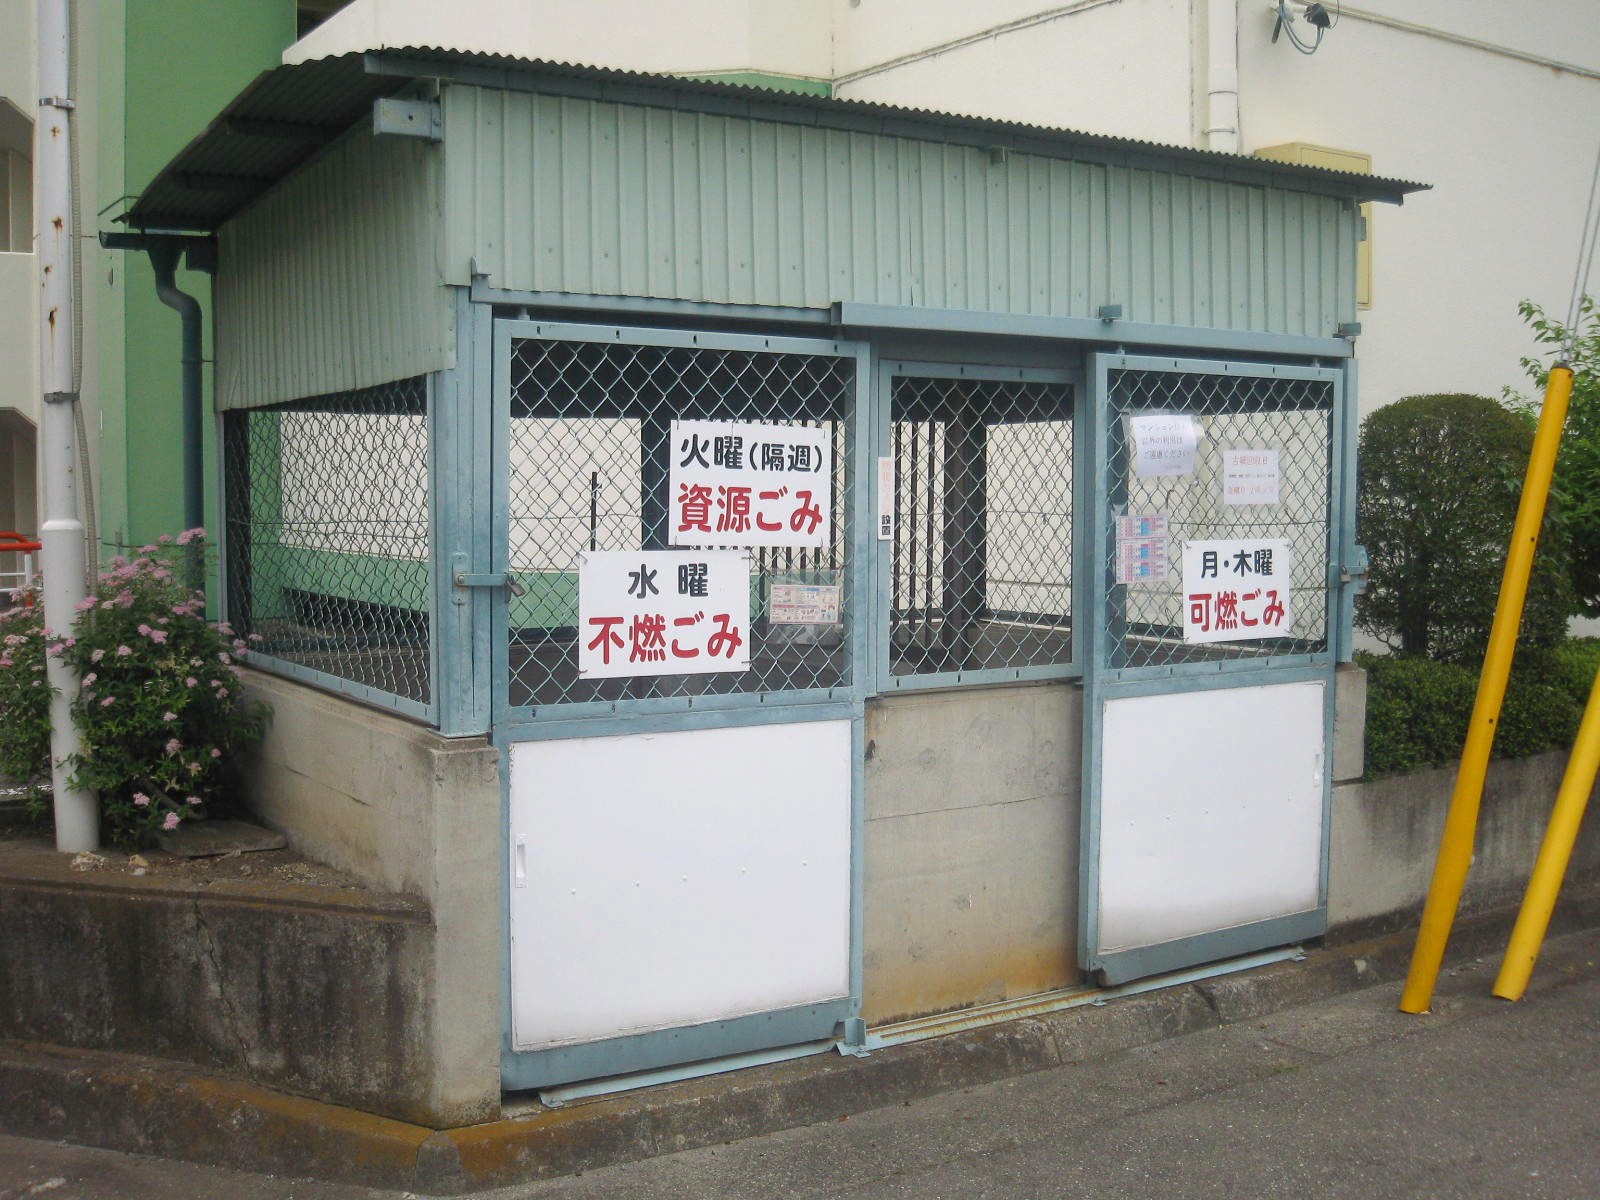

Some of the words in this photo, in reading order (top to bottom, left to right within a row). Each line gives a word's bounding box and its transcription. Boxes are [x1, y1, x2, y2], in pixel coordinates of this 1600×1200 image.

[677, 482, 823, 535] 資源ごみ
[1201, 549, 1273, 579] 月・木曜
[1189, 588, 1285, 632] 可燃ごみ
[587, 611, 742, 665] 不燃ごみ
